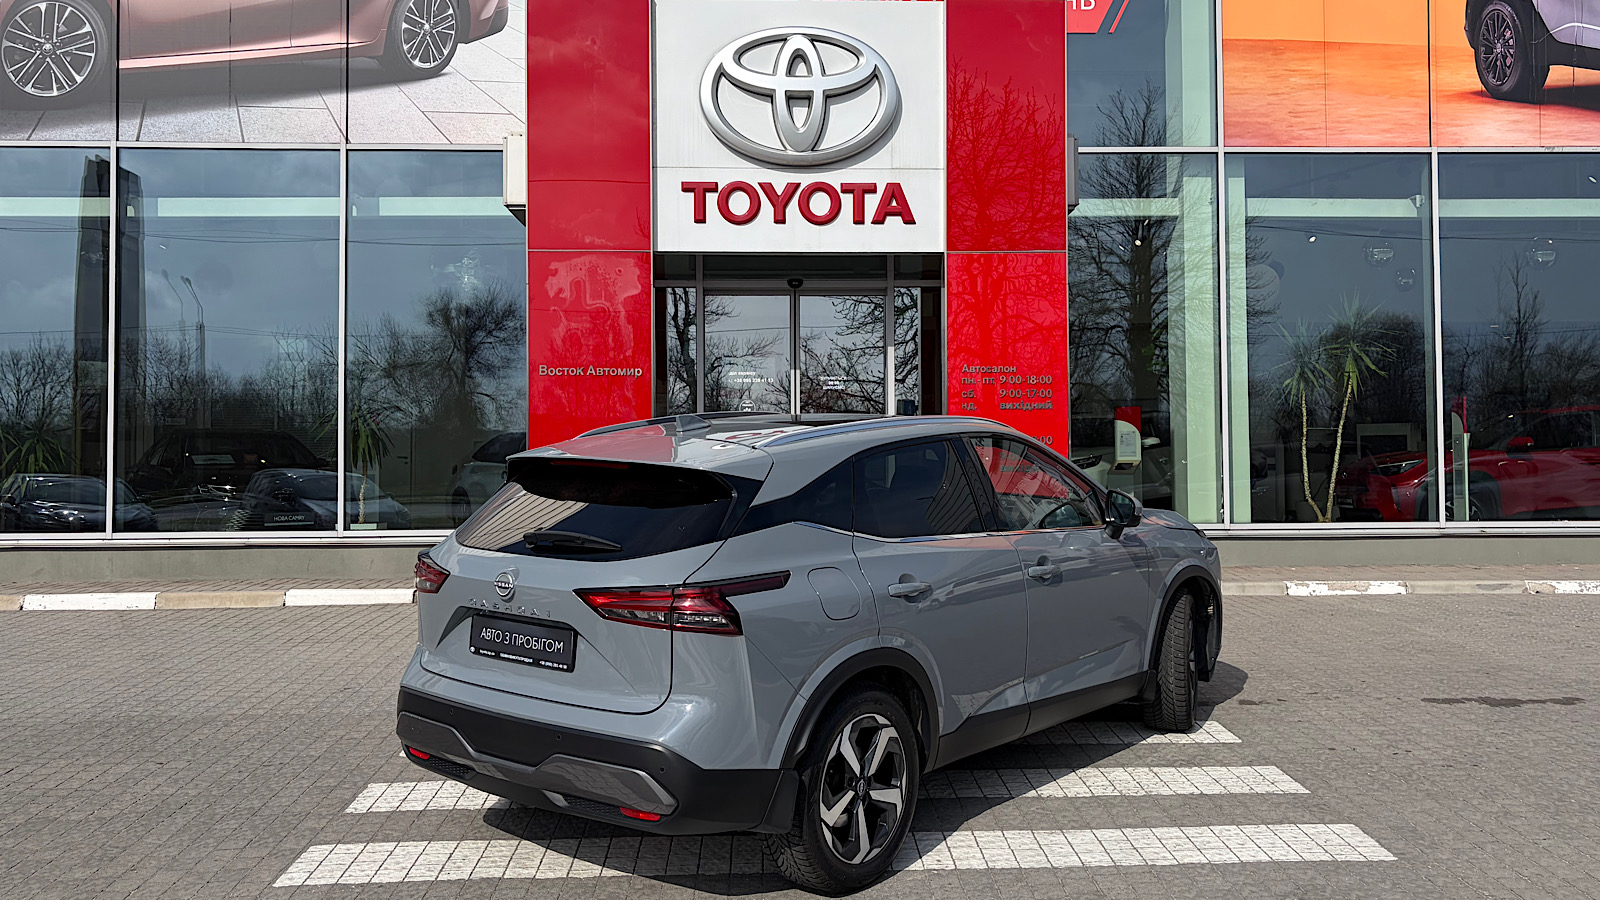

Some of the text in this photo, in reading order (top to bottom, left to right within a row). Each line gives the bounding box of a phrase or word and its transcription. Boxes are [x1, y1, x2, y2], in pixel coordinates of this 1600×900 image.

[681, 181, 916, 226] TOYOTA
[539, 364, 643, 379] Восток Автомир
[961, 364, 1017, 373] Автосалон
[1000, 375, 1053, 385] 9:00-18:00
[961, 389, 1053, 399] сб. 9:00-17:00
[961, 400, 1053, 411] нд. вихідний
[480, 627, 503, 643] АВТО
[512, 633, 565, 654] ПРОБІГОМ
